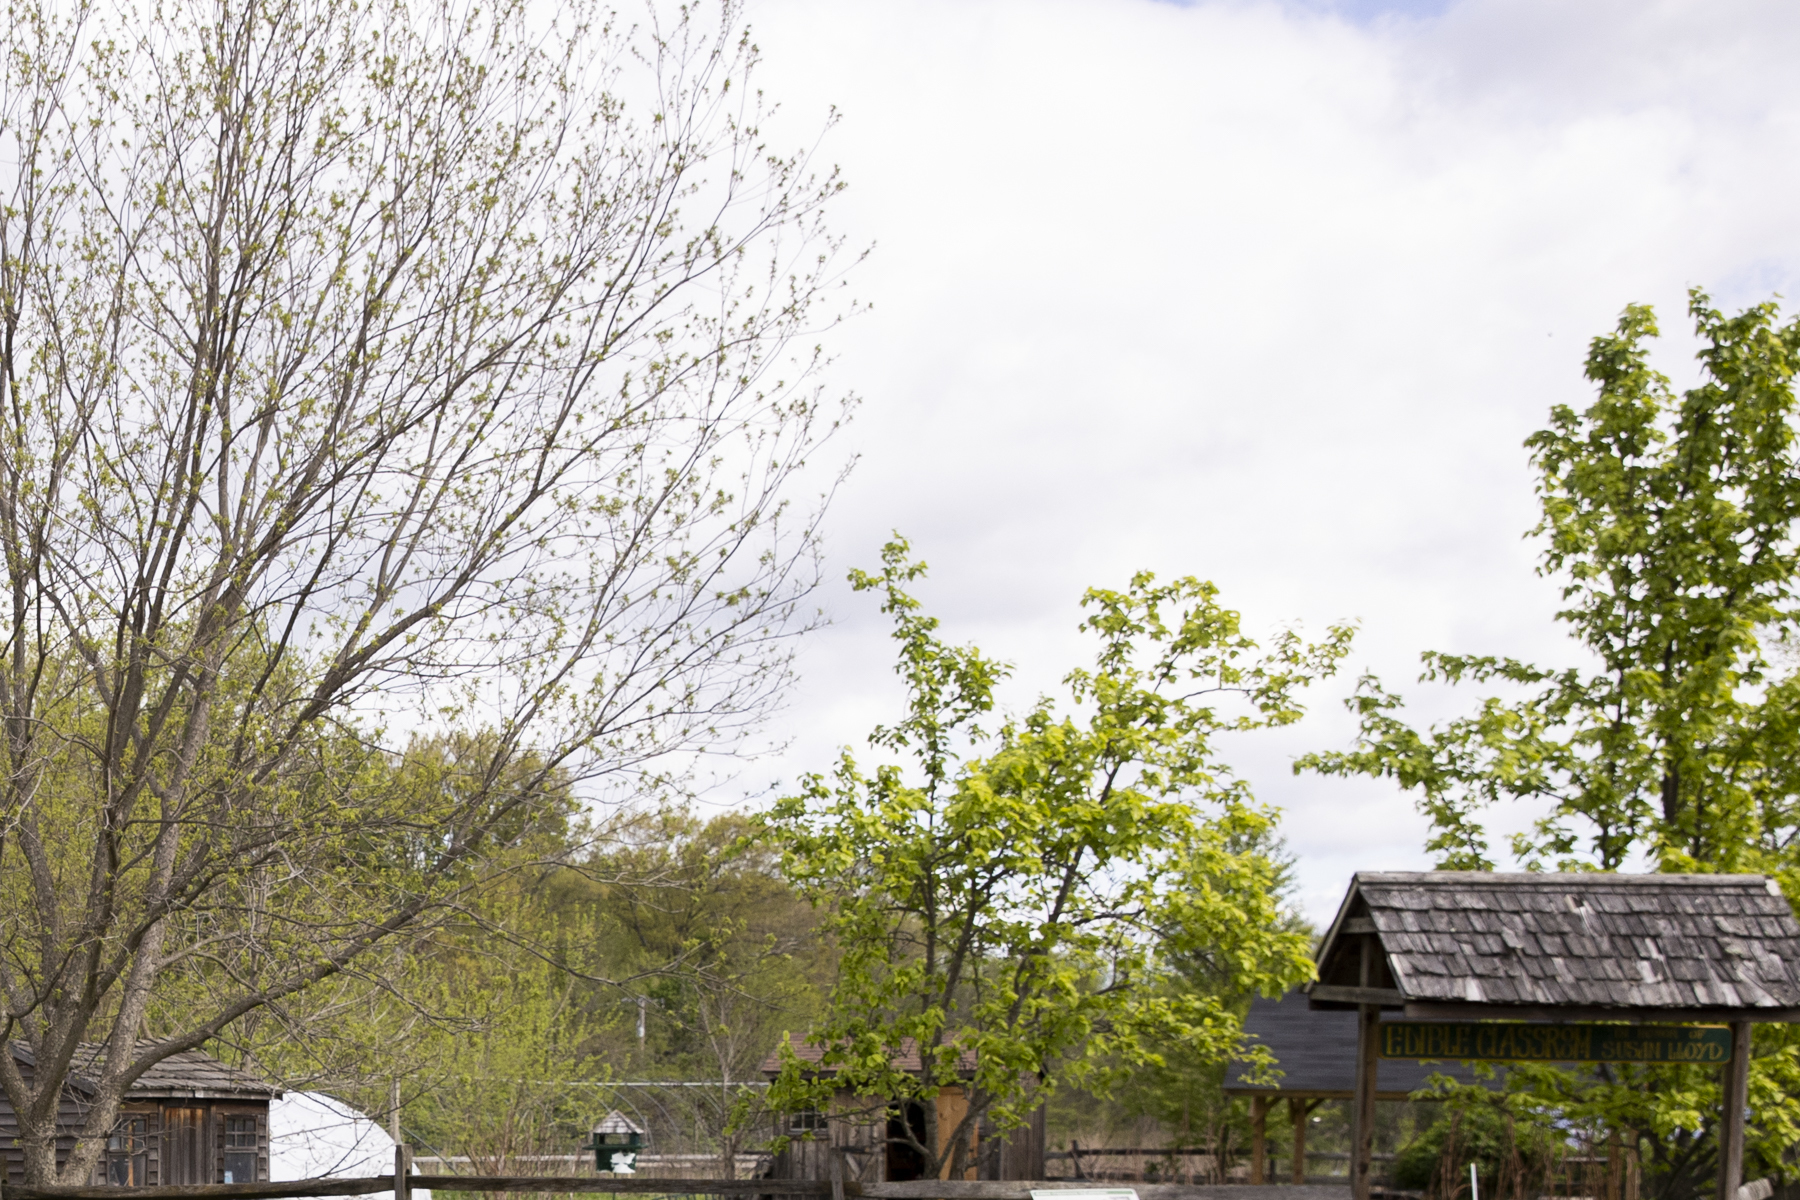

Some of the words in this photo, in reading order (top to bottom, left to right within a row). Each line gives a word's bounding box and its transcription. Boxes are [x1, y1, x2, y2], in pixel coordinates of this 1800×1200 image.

[1386, 1025, 1470, 1056] EDIBLE
[1601, 1041, 1661, 1059] SUSAN
[1668, 1042, 1724, 1060] LLOYD
